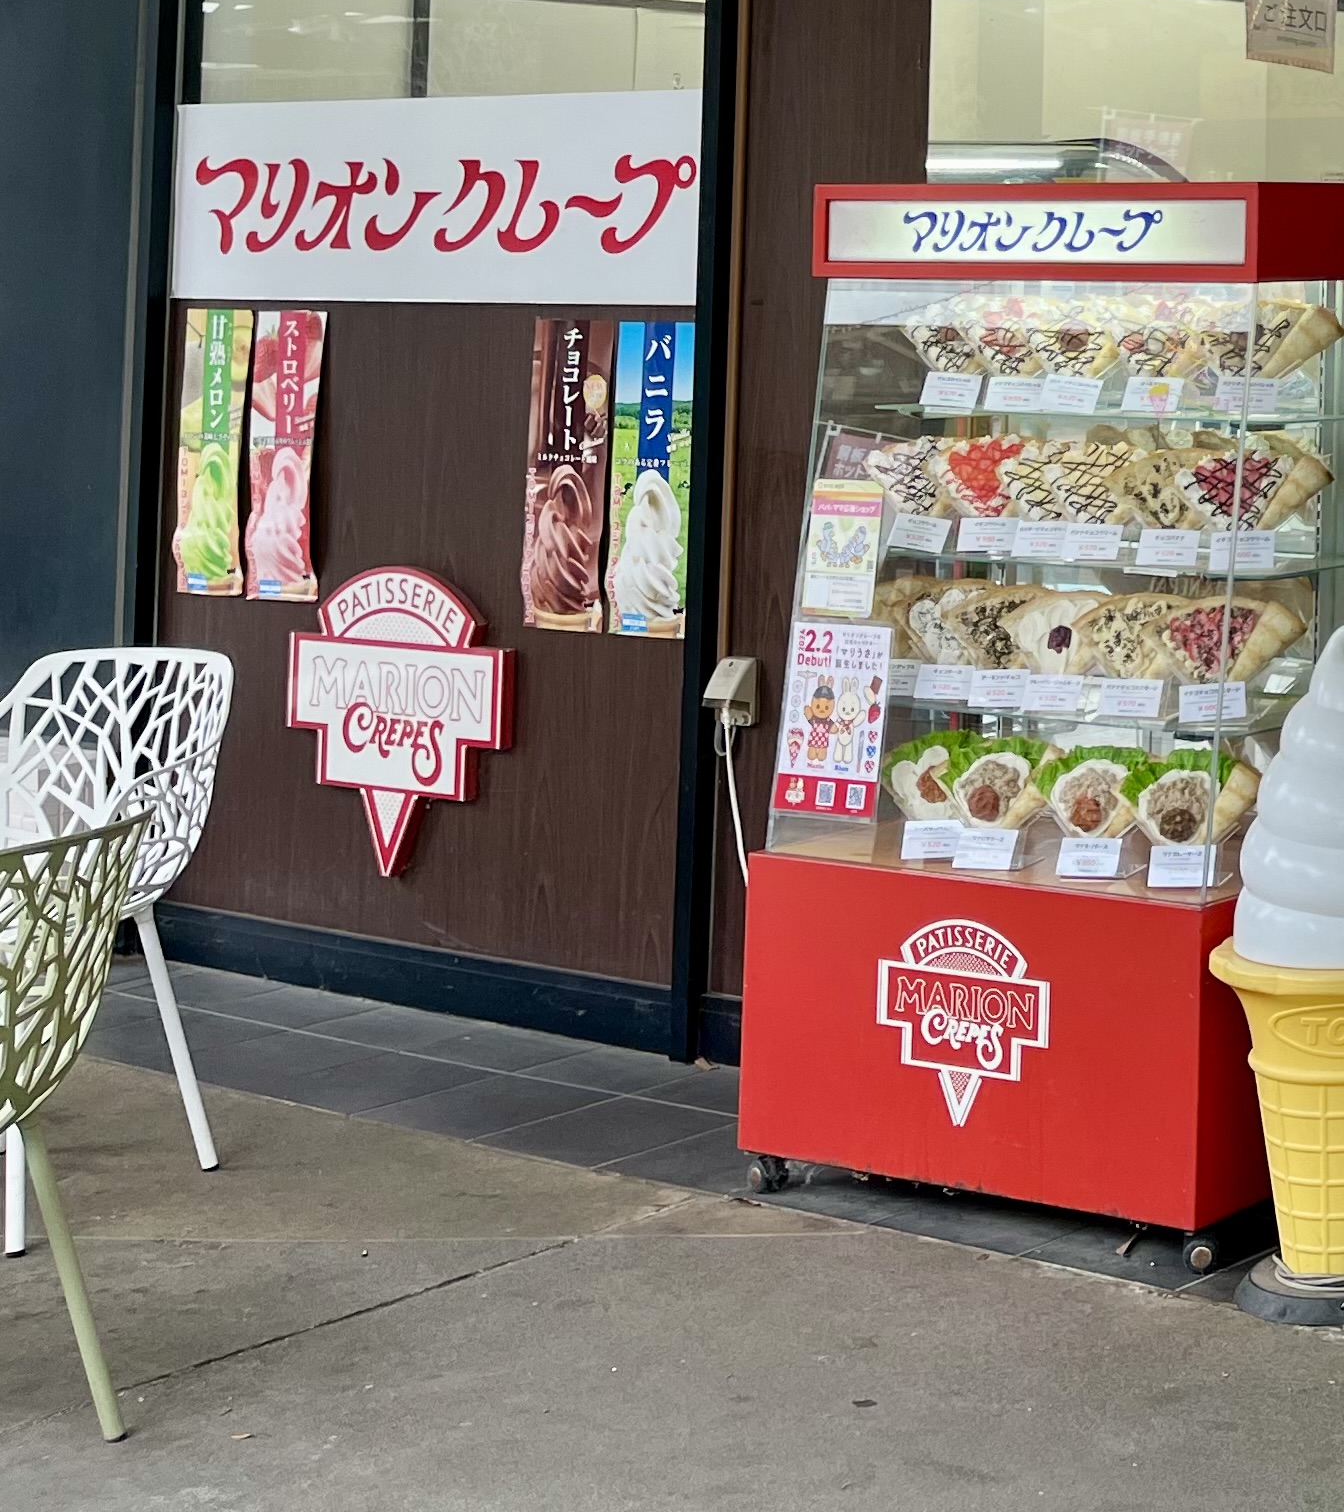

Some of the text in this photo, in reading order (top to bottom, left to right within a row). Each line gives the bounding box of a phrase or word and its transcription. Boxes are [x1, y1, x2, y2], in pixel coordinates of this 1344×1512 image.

[195, 154, 697, 255] マリオンクレープ
[902, 208, 1164, 255] マリオンクレープ
[208, 314, 228, 429] 甘熟メロン
[280, 319, 300, 434] ストロベリー
[561, 327, 584, 451] チョコレート
[644, 334, 673, 440] バニラ
[335, 581, 459, 634] PATISSERIE
[797, 653, 832, 668] Debut!
[805, 629, 833, 653] 2.2
[310, 655, 486, 725] MARION
[916, 926, 1013, 970] PATISSERIE
[894, 975, 1035, 1030] MARION
